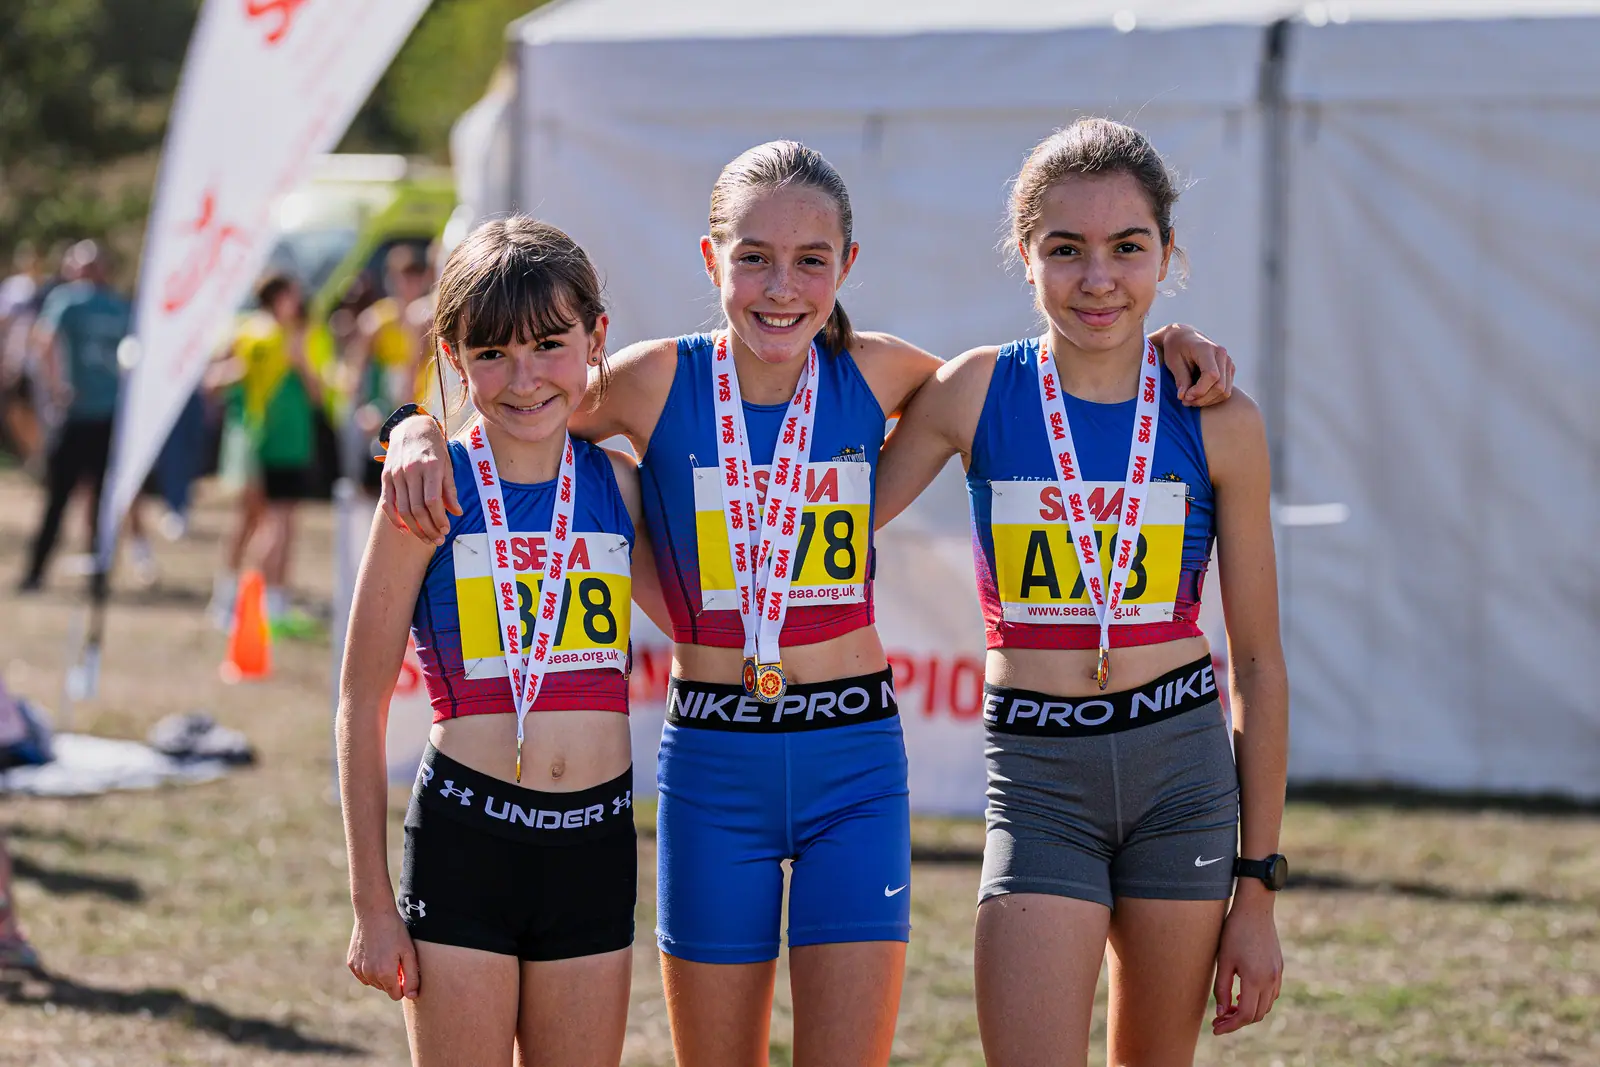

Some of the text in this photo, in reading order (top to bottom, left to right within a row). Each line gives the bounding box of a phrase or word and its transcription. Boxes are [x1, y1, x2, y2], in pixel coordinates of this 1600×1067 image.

[718, 373, 731, 402] SEAA
[1144, 376, 1156, 403] SEAA
[470, 425, 484, 450] SEAA
[722, 415, 735, 444] SEAA
[1138, 415, 1152, 444] SEAA
[478, 460, 494, 486] SEAA
[725, 457, 739, 487] SEAA
[767, 497, 782, 527] SEAA
[775, 457, 790, 486] SEAA
[783, 417, 798, 444] SEAA
[1132, 455, 1147, 485] SEAA
[561, 475, 571, 503] SEAA
[1043, 373, 1056, 401] SEAA
[1050, 412, 1065, 440] SEAA
[1059, 452, 1076, 481] SEAA
[1069, 493, 1085, 523] SEAA
[1079, 535, 1095, 564] SEAA
[1090, 577, 1103, 605] SEAA
[487, 498, 502, 526] SEAA
[729, 500, 744, 529] SEAA
[782, 507, 797, 536] SEAA
[1125, 497, 1140, 527] SEAA
[555, 513, 568, 541] SEAA
[495, 539, 508, 569] SEAA
[510, 537, 591, 571] SEA
[550, 552, 563, 580] SEAA
[735, 542, 747, 572] SEAA
[774, 549, 790, 579] SEAA
[1020, 530, 1147, 600] A78
[1118, 539, 1132, 569] SEAA
[501, 582, 514, 611] SEAA
[542, 591, 557, 620] SEAA
[740, 586, 749, 615] SEAA
[767, 591, 783, 621] SEAA
[1110, 581, 1122, 610] SEAA
[507, 624, 518, 654] SEAA
[534, 632, 549, 661] SEAA
[527, 673, 539, 702] SEAA
[1006, 699, 1115, 727] PRO
[1129, 664, 1216, 720] NIKE
[669, 687, 762, 723] NIKE
[772, 686, 871, 723] PRO
[484, 795, 605, 830] UNDER
